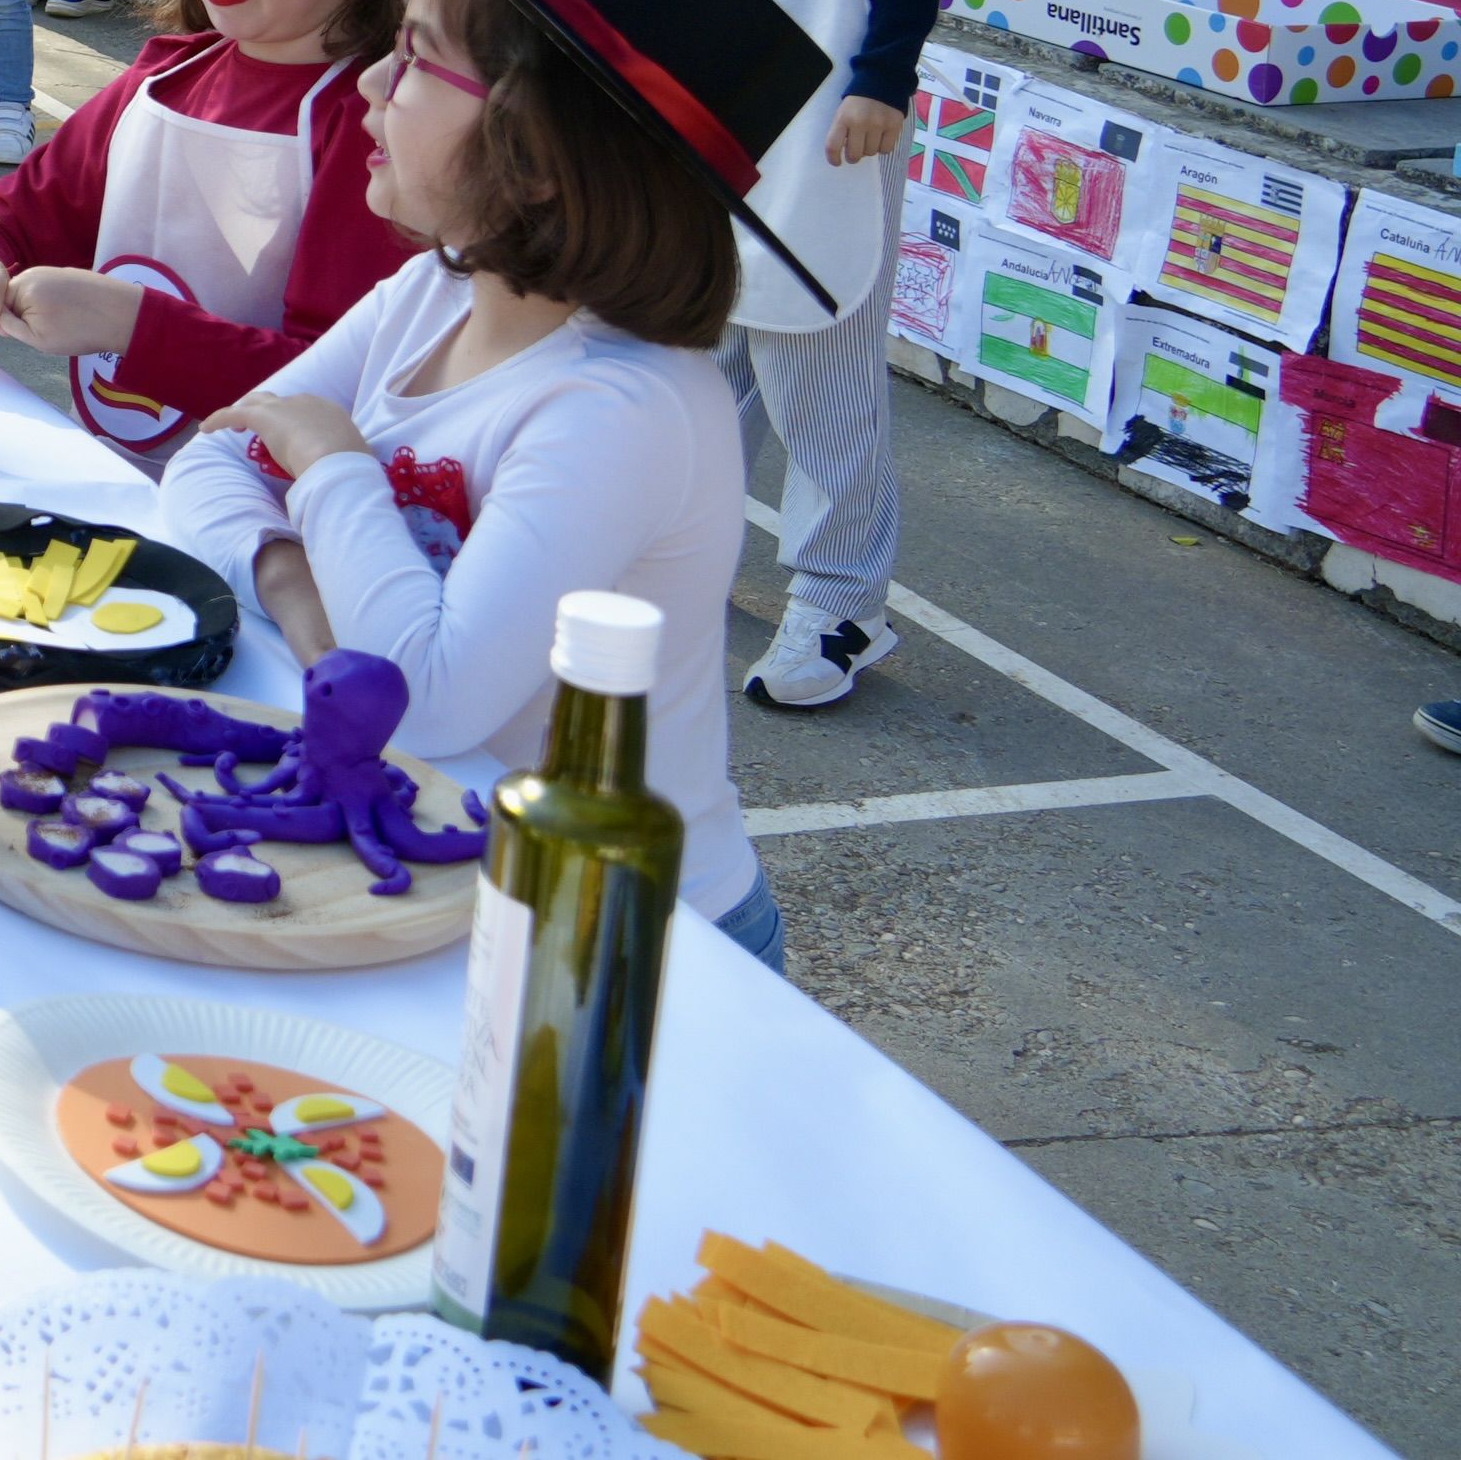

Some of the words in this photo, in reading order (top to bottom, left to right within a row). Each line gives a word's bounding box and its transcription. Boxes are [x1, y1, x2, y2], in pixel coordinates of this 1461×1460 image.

[1047, 3, 1141, 46] Santillana
[1029, 106, 1062, 128] Navarra
[1180, 165, 1218, 185] Aragón
[1380, 228, 1430, 254] Cataluña
[1152, 336, 1210, 369] Extremadura
